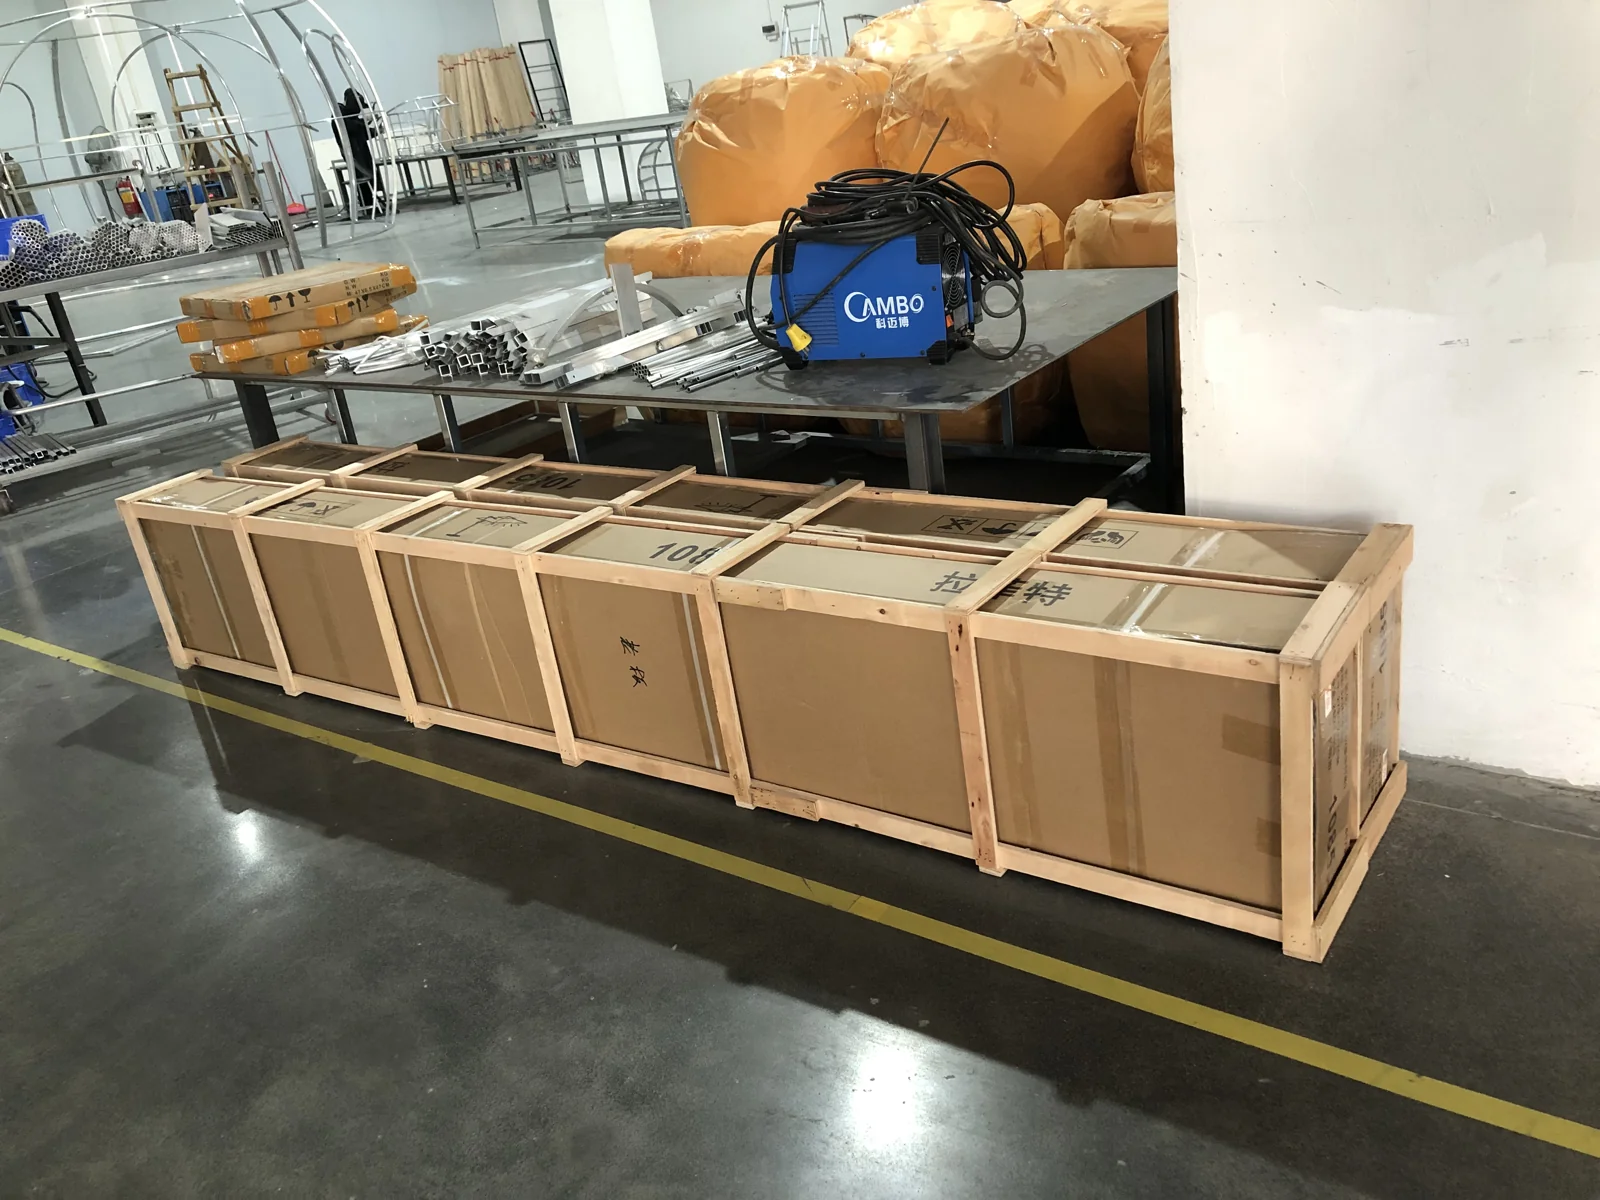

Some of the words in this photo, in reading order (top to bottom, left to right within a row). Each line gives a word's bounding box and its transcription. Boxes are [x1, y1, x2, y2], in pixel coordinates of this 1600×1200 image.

[844, 291, 925, 323] CAMBO
[875, 316, 910, 330] 科迈博
